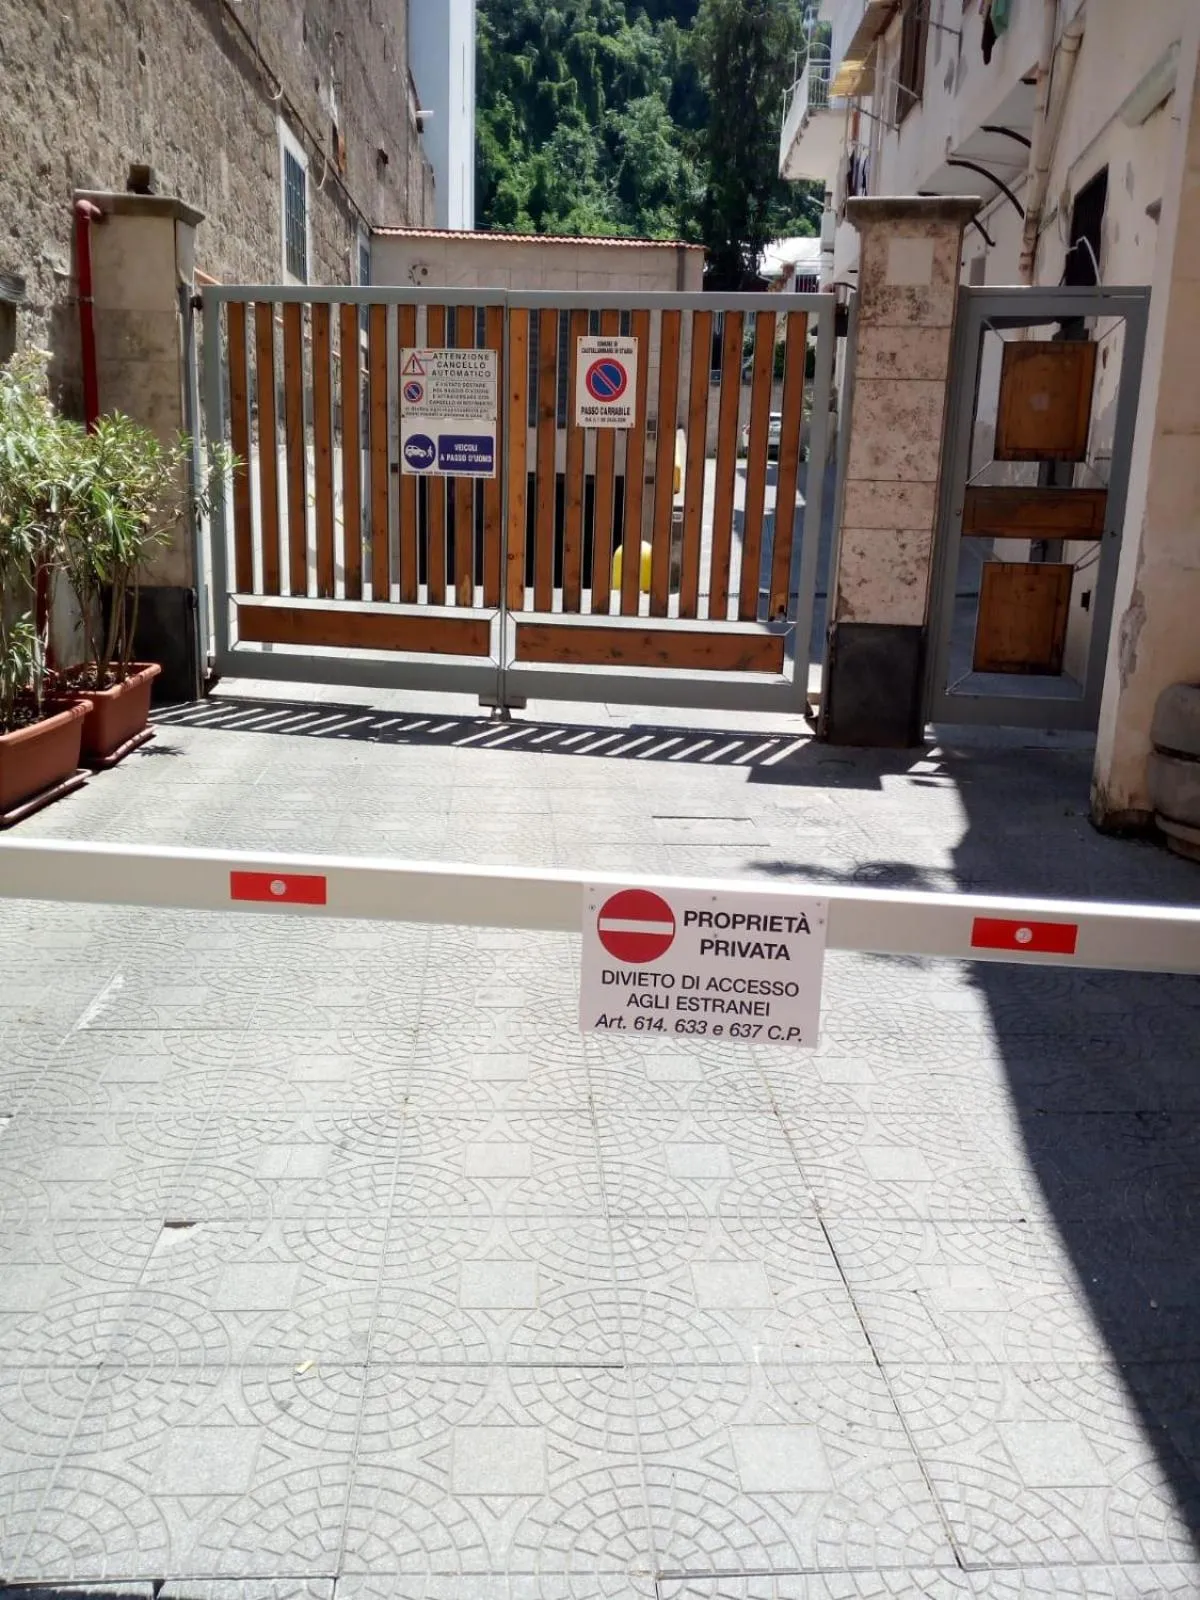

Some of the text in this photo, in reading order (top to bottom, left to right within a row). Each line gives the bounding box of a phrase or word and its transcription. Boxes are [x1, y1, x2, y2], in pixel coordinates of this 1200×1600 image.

[433, 352, 490, 361] ATTENZIONE
[436, 361, 486, 369] CANCELLO
[431, 369, 491, 378] AUTOMATICO
[581, 406, 630, 416] PASSO CARRABILE
[454, 444, 478, 452] VEICOLI
[440, 453, 492, 463] A PASSO D'UOMO
[683, 910, 811, 935] PROPRIETÀ
[700, 938, 791, 961] PRIVATA
[601, 970, 800, 998] DIVIETO DI ACCESSO
[626, 993, 770, 1017] AGLI ESTRANEI
[594, 1013, 627, 1030] Art.
[674, 1018, 708, 1035] 633
[712, 1024, 724, 1036] e
[729, 1022, 763, 1039] 637
[767, 1025, 802, 1042] C.P.
